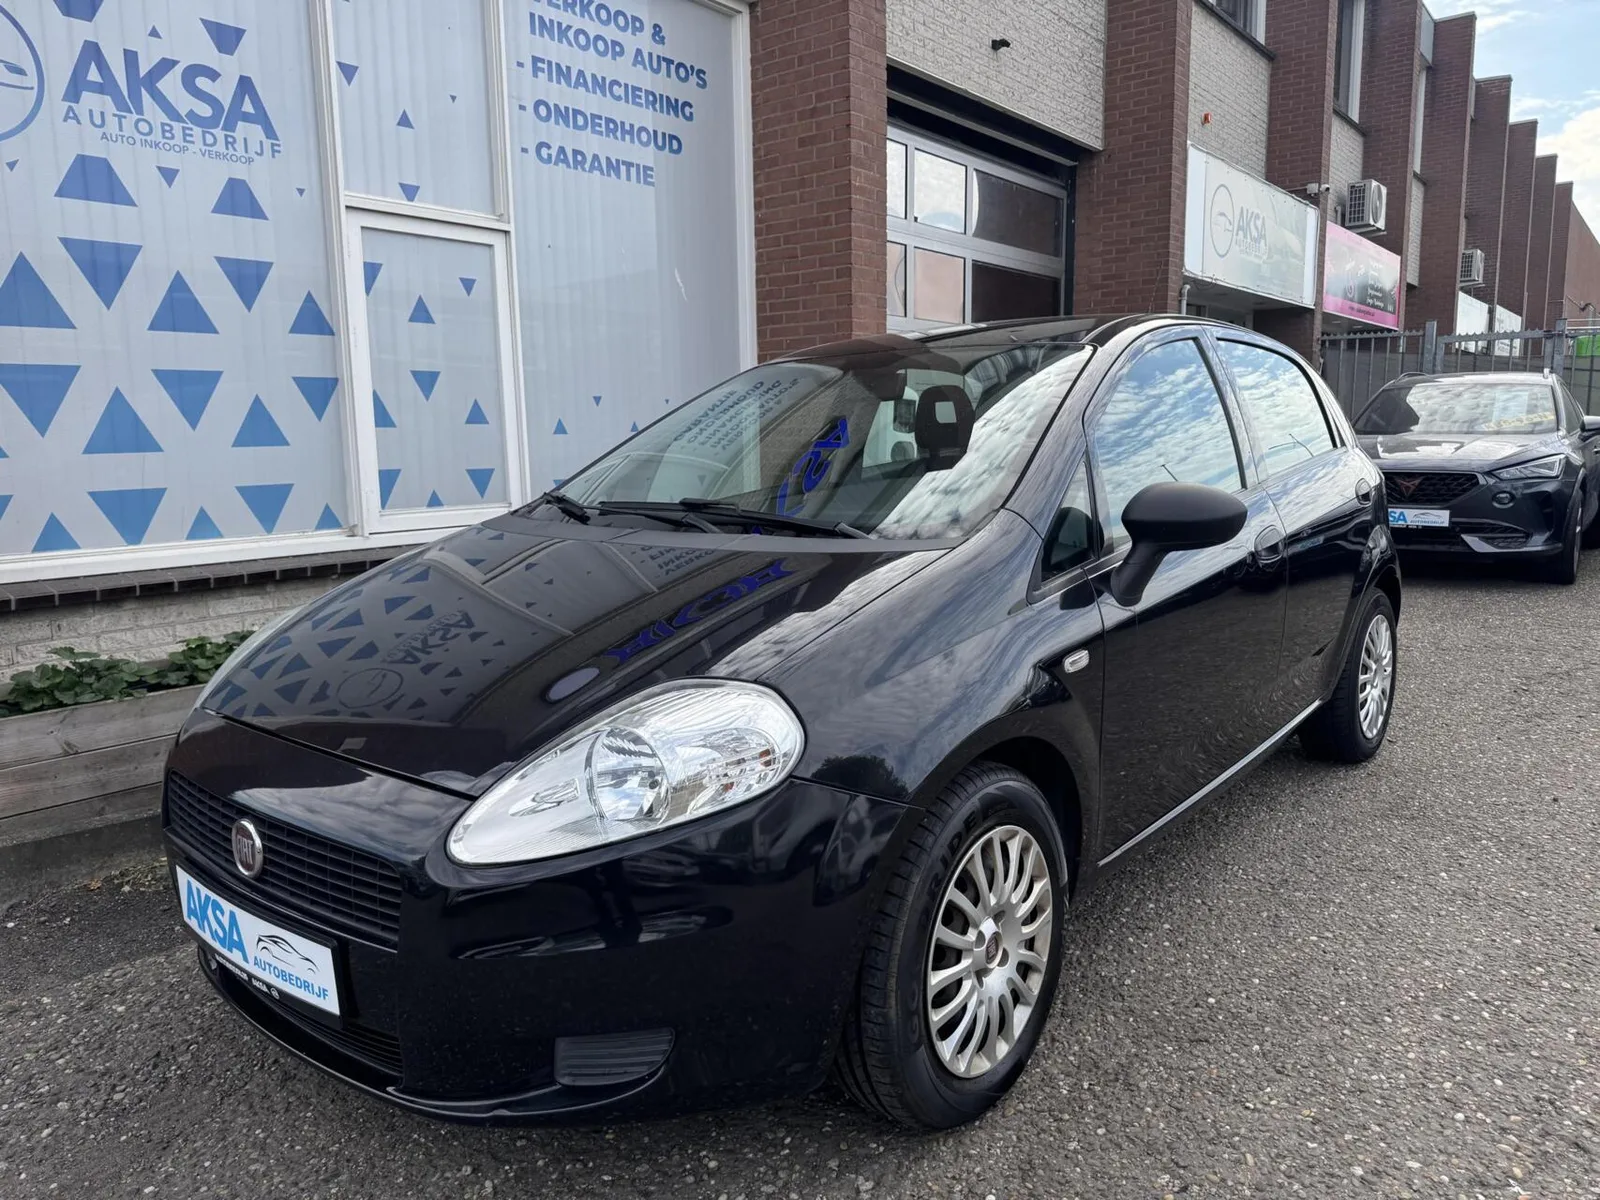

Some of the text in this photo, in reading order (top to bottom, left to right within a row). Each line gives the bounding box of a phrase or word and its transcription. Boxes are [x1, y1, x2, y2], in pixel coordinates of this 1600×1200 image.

[529, 11, 708, 90] INKOOP AUTO'S
[652, 23, 666, 46] &
[61, 39, 280, 142] AKSA
[531, 55, 694, 122] FINANCIERING
[62, 105, 282, 159] AUTOBEDRIJF
[100, 131, 136, 146] AUTO
[140, 138, 189, 155] INKOOP
[200, 149, 255, 166] VERKOOP
[533, 99, 683, 155] ONDERHOUD
[535, 141, 655, 188] GARANTIE
[1235, 205, 1268, 247] AKSA
[236, 833, 254, 865] FIAT
[186, 879, 249, 964] AKSA
[254, 955, 329, 1000] AUTOBEDRIJF
